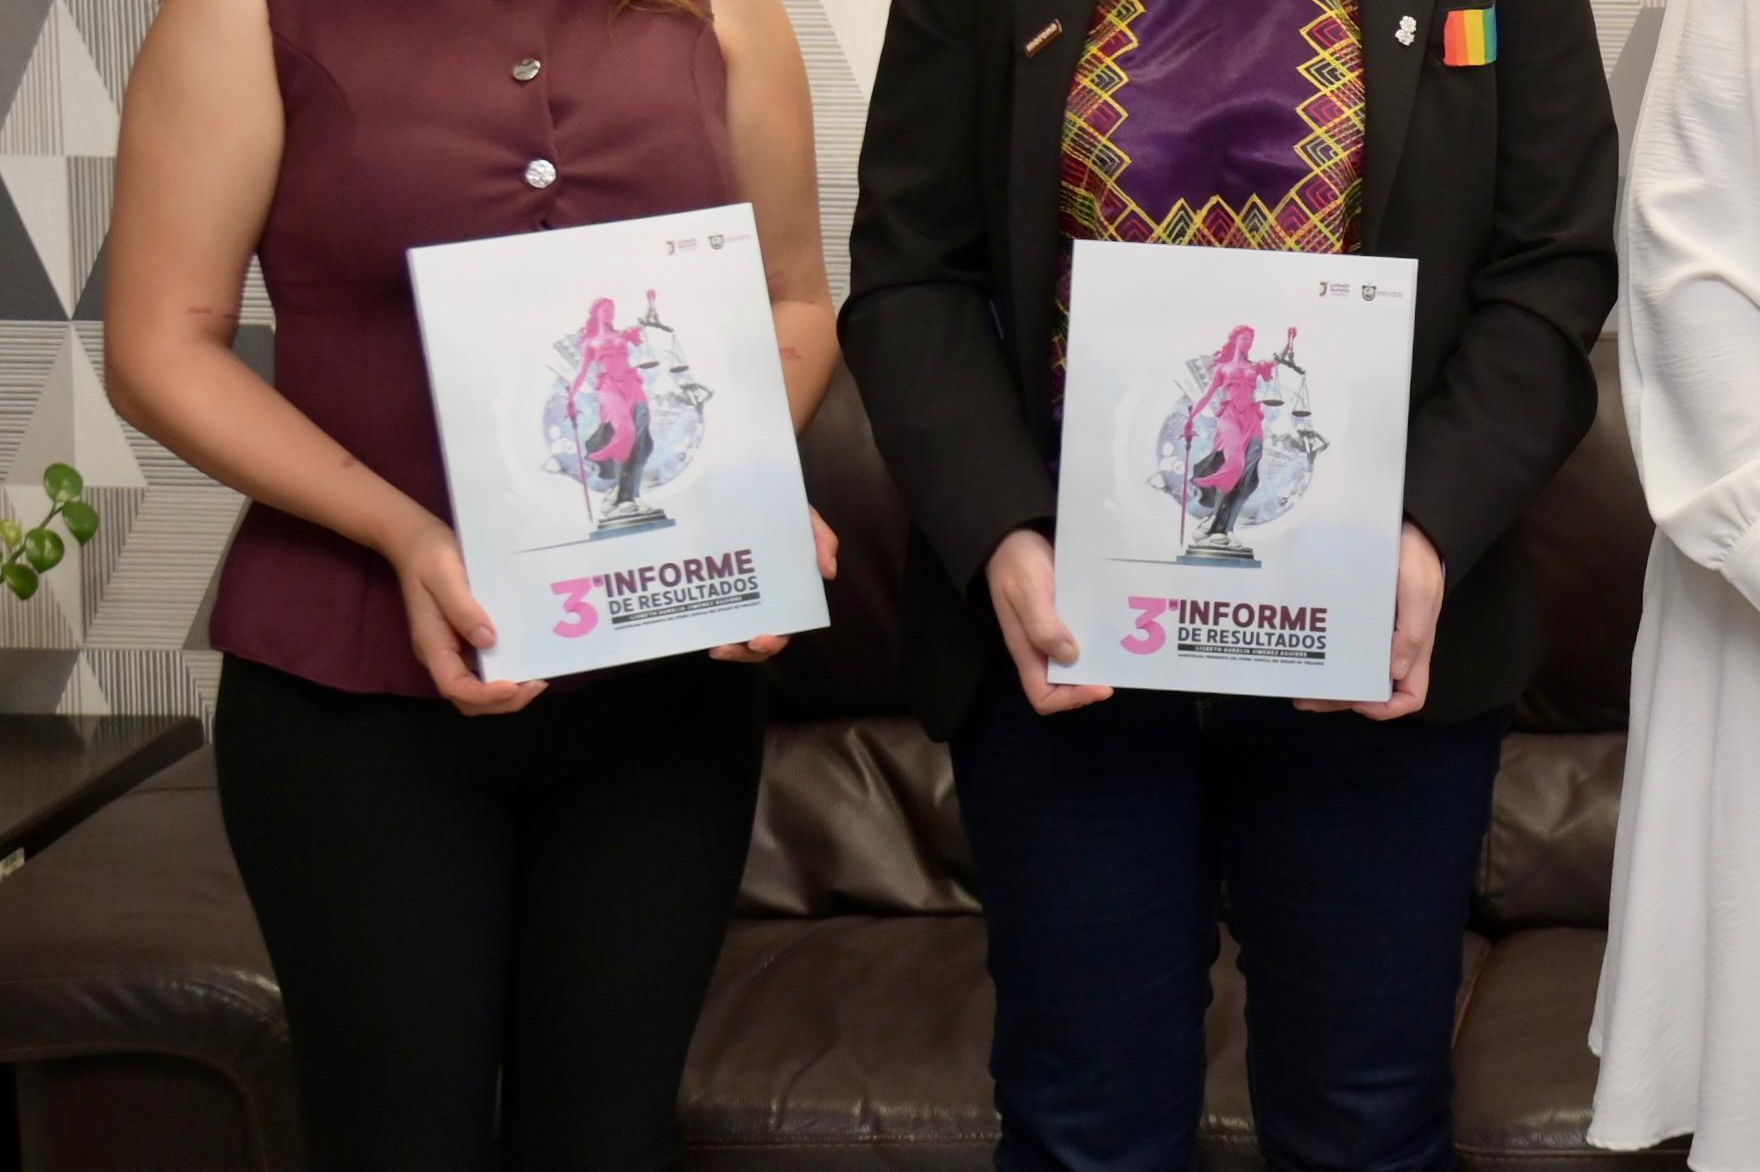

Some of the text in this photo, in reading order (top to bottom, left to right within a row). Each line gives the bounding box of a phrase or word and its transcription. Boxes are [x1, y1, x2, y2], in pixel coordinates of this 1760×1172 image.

[603, 549, 756, 598] INFORME
[608, 598, 634, 615] DE
[639, 576, 759, 611] RESULTADOS
[1178, 599, 1328, 633] INFORME
[1178, 627, 1326, 650] DE RESULTADOS
